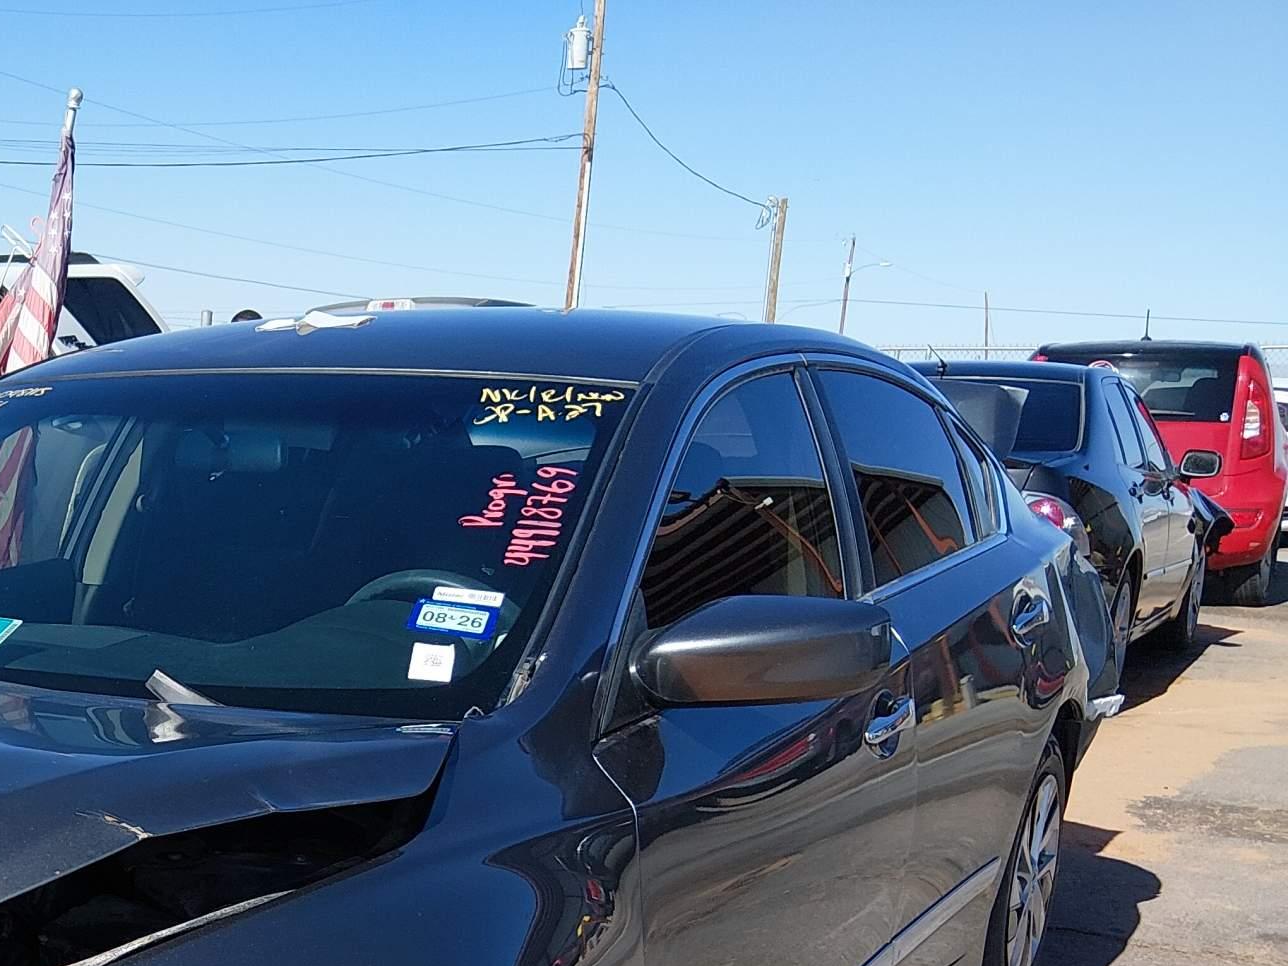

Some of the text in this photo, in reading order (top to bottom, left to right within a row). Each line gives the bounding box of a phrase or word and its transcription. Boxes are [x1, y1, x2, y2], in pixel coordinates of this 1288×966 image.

[503, 466, 579, 566] 44918769
[422, 610, 448, 624] 08
[456, 615, 484, 629] 26
